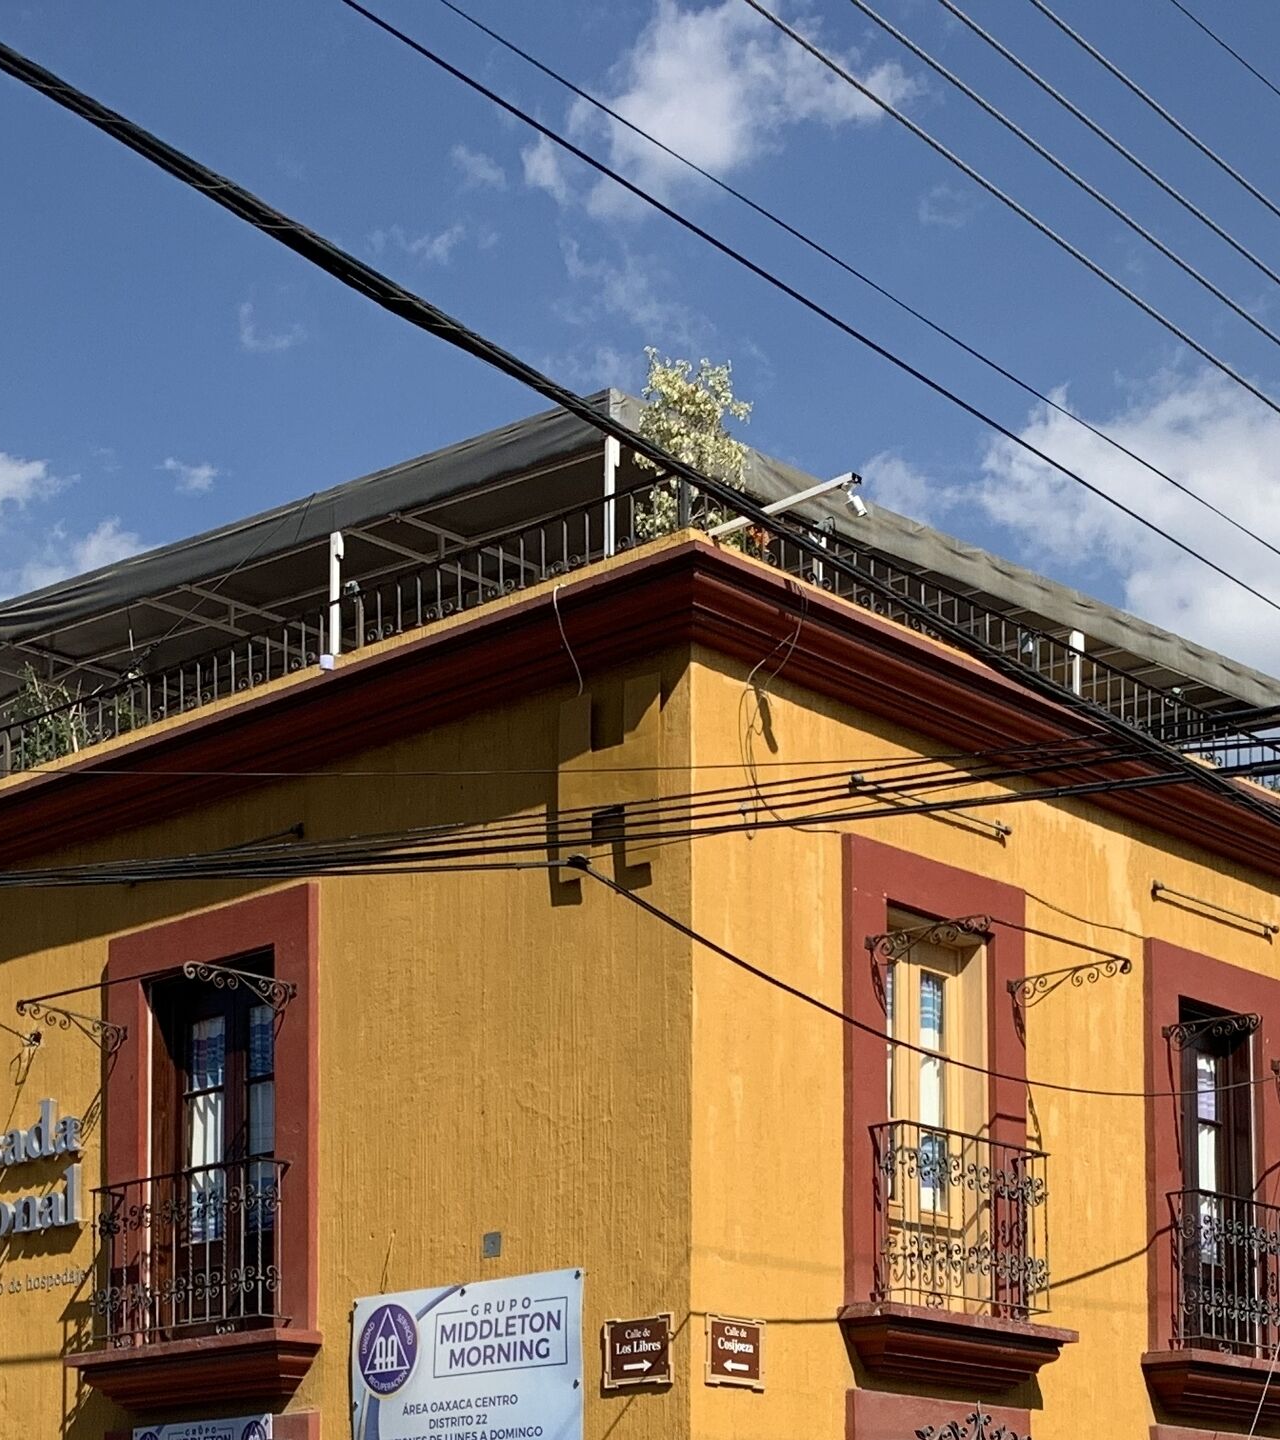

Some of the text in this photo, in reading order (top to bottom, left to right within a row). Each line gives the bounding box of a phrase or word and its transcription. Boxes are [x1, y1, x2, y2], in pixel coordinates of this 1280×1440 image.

[26, 1265, 86, 1292] hospedaje
[471, 1296, 531, 1316] GRUPO
[362, 1321, 375, 1354] UNIDAD
[440, 1310, 561, 1345] MIDDLETON
[625, 1328, 651, 1339] Calle de
[724, 1326, 747, 1338] Calle de
[449, 1337, 551, 1369] MORNING
[615, 1340, 661, 1355] Los Libres
[402, 1394, 519, 1416] ÁREA OAXACA CENTRO
[429, 1414, 488, 1430] DISTRITO 22
[480, 1431, 488, 1440] A
[490, 1426, 543, 1440] DOMINGO
